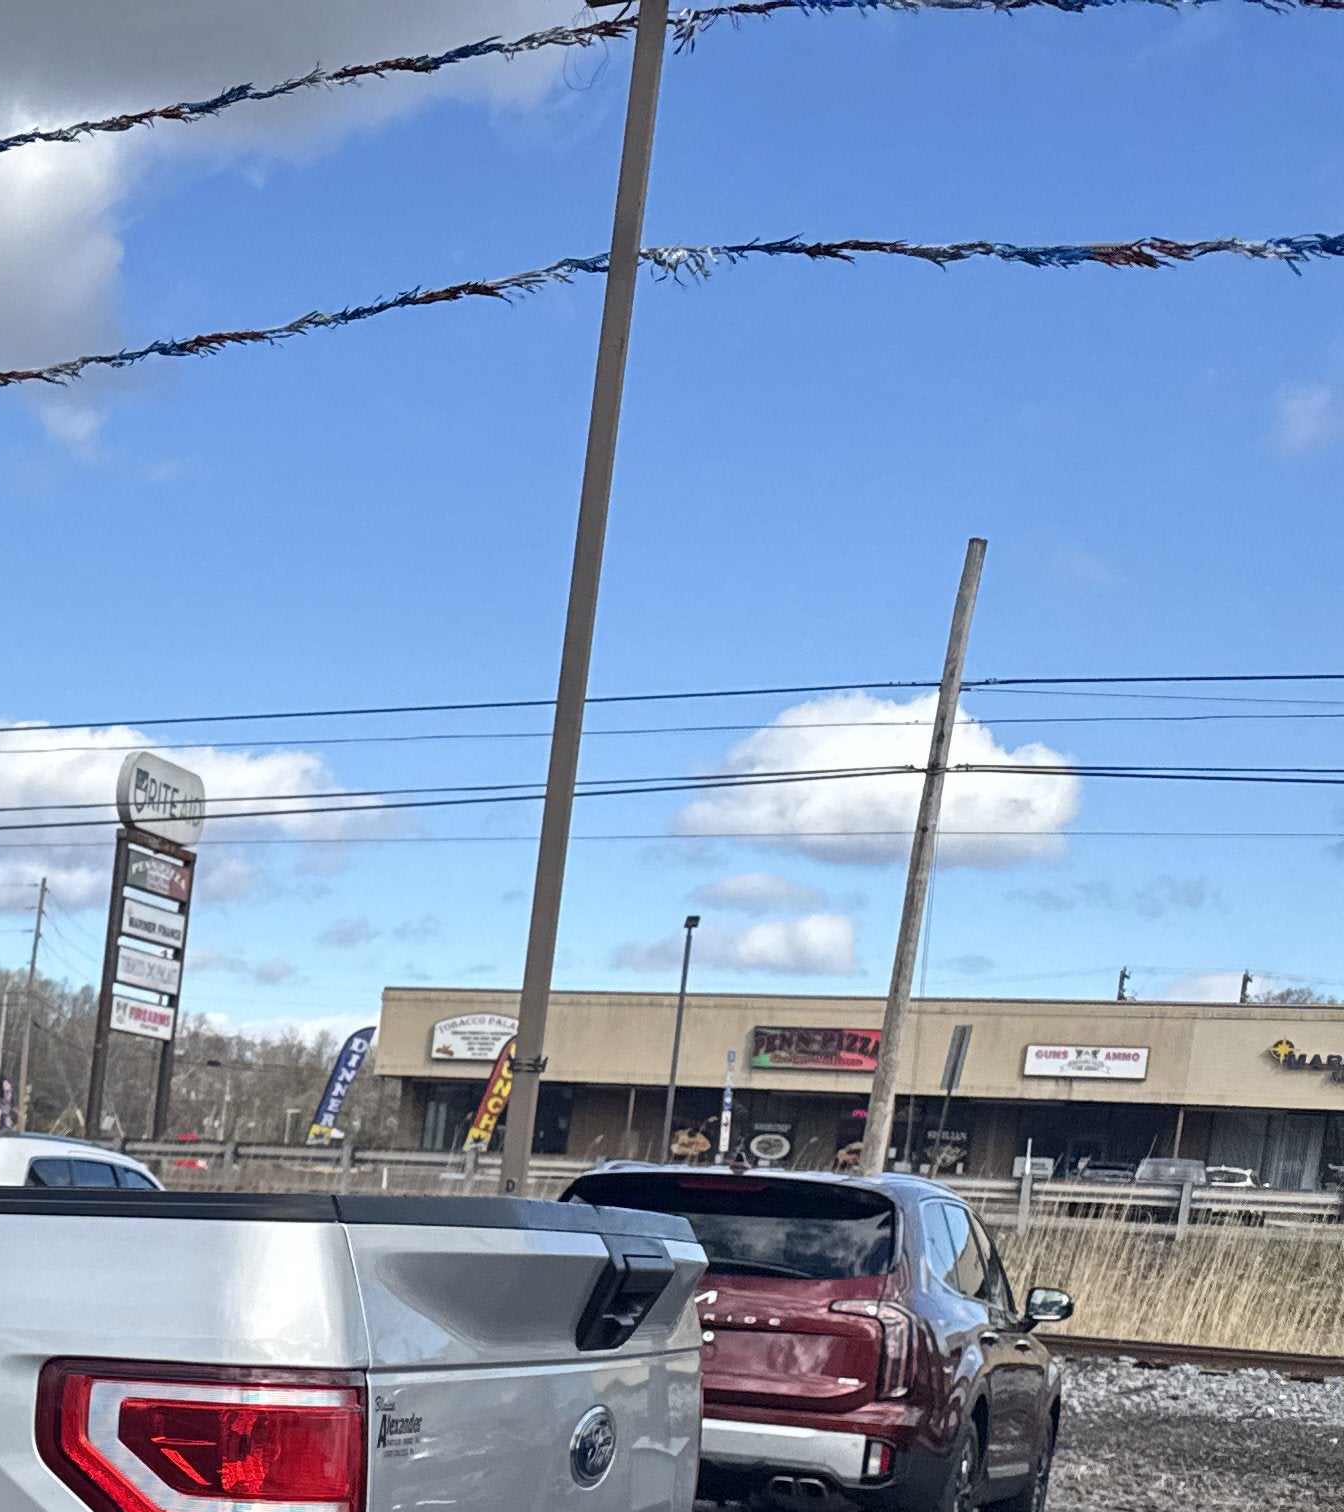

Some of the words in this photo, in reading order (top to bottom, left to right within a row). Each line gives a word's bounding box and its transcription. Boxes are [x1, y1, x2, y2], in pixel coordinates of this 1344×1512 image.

[438, 1016, 488, 1034] TOBACCO
[1035, 1049, 1069, 1060] GUNS
[1104, 1051, 1141, 1062] AMMO
[319, 1037, 369, 1127] DINNER
[376, 1411, 423, 1449] Alexander
